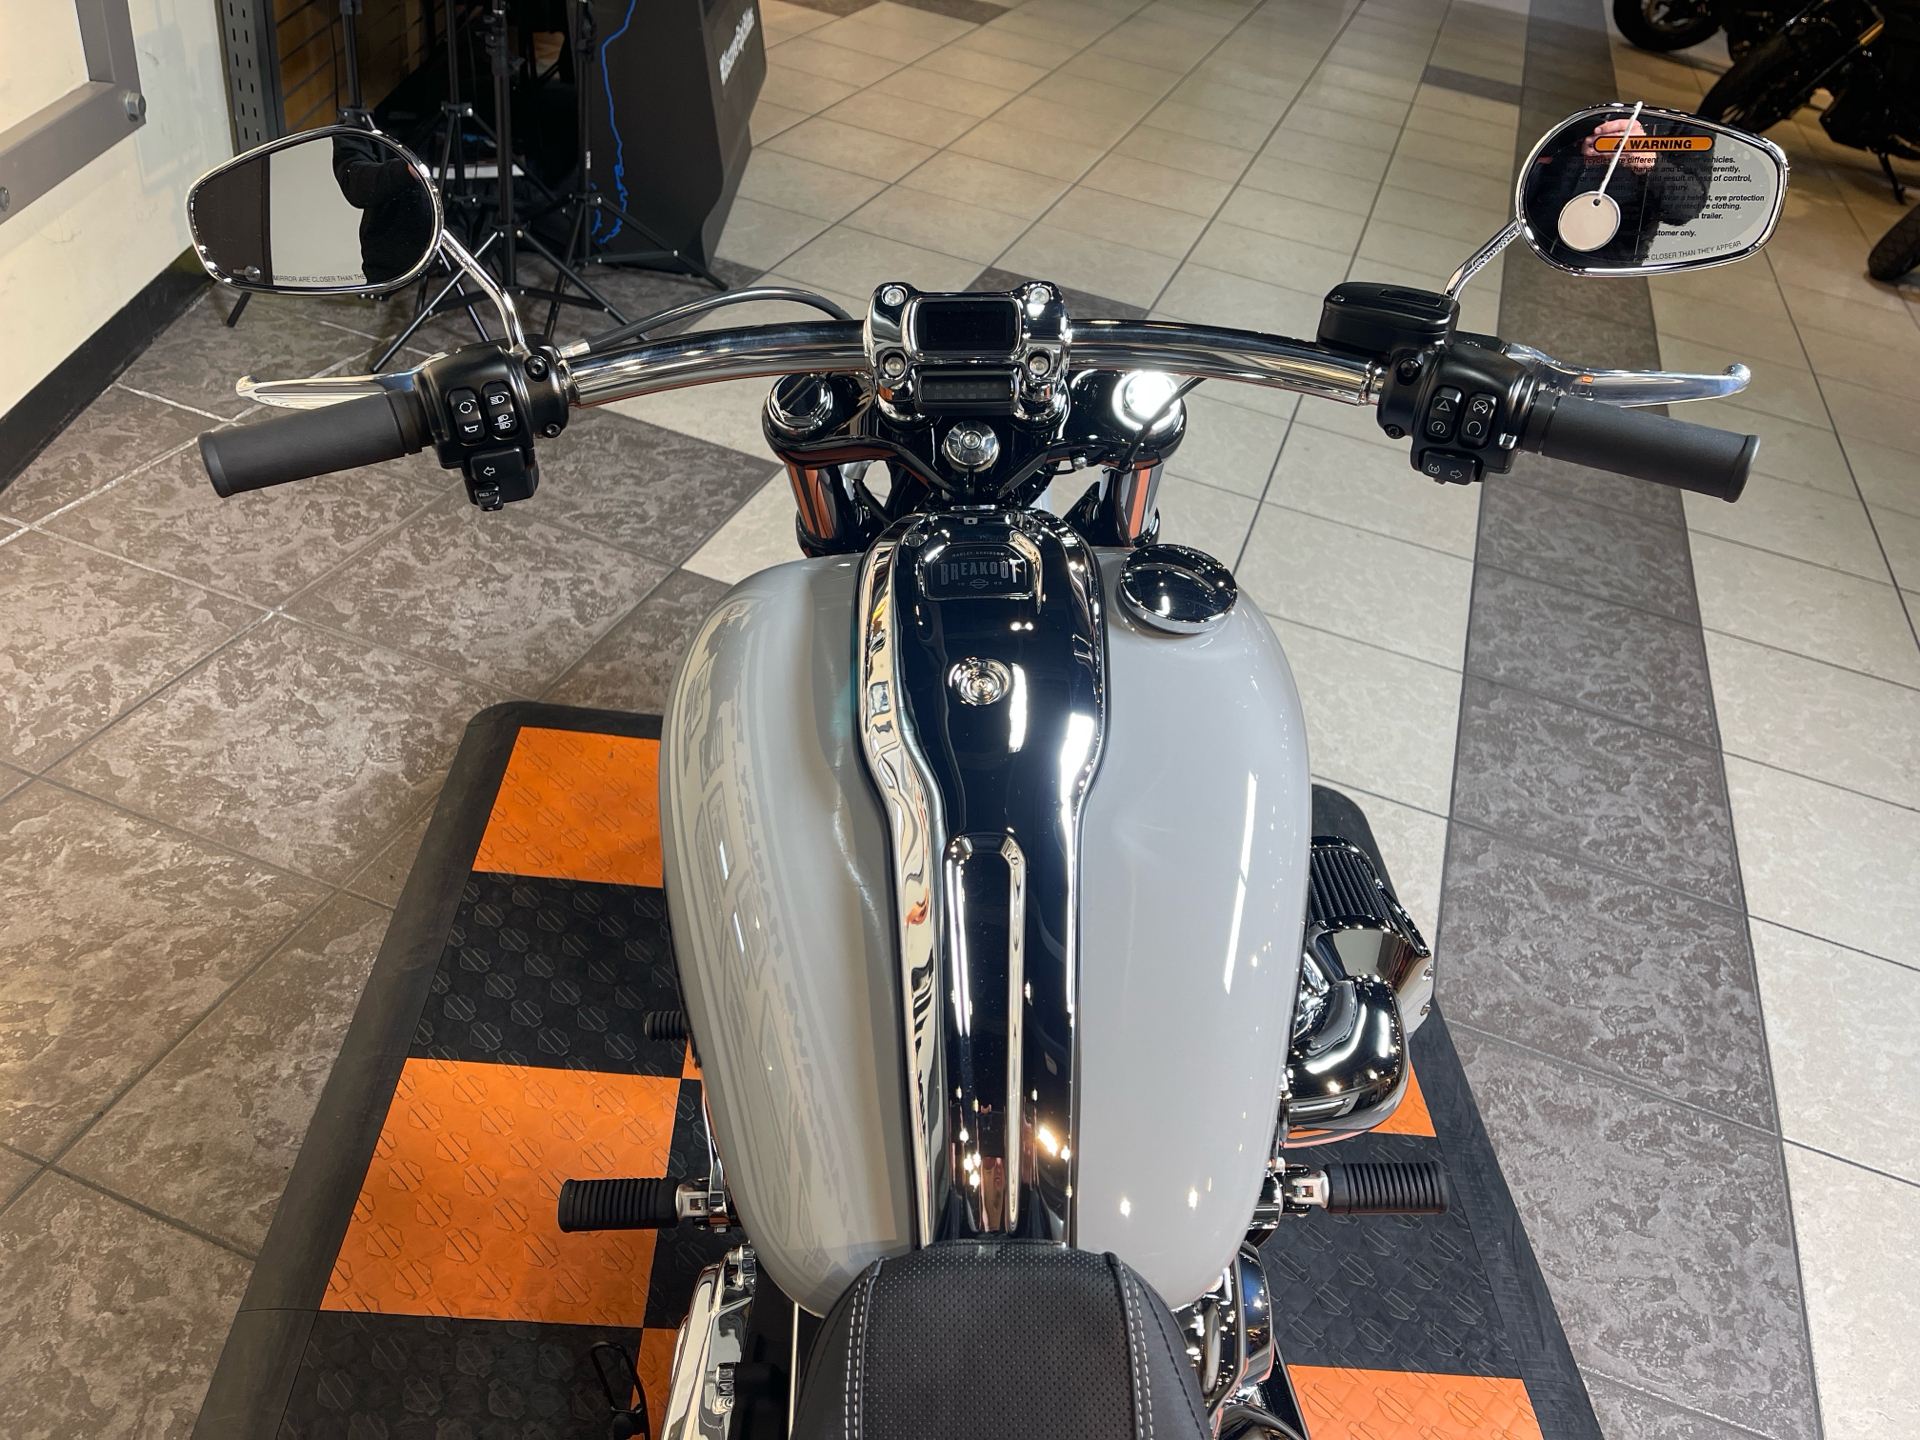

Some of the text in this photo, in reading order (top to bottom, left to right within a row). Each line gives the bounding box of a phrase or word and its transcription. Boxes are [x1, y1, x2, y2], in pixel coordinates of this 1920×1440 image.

[1630, 140, 1692, 149] WARNING
[1627, 155, 1660, 164] different
[1723, 174, 1752, 183] control,
[1728, 194, 1765, 202] protection
[1711, 202, 1742, 211] clothing.
[1680, 229, 1697, 238] only.
[1651, 252, 1677, 260] CLOSER
[1678, 250, 1696, 258] THAN
[1697, 247, 1715, 255] THEY
[1716, 241, 1742, 251] APPEAR
[940, 559, 1020, 586] BREAKOUT
